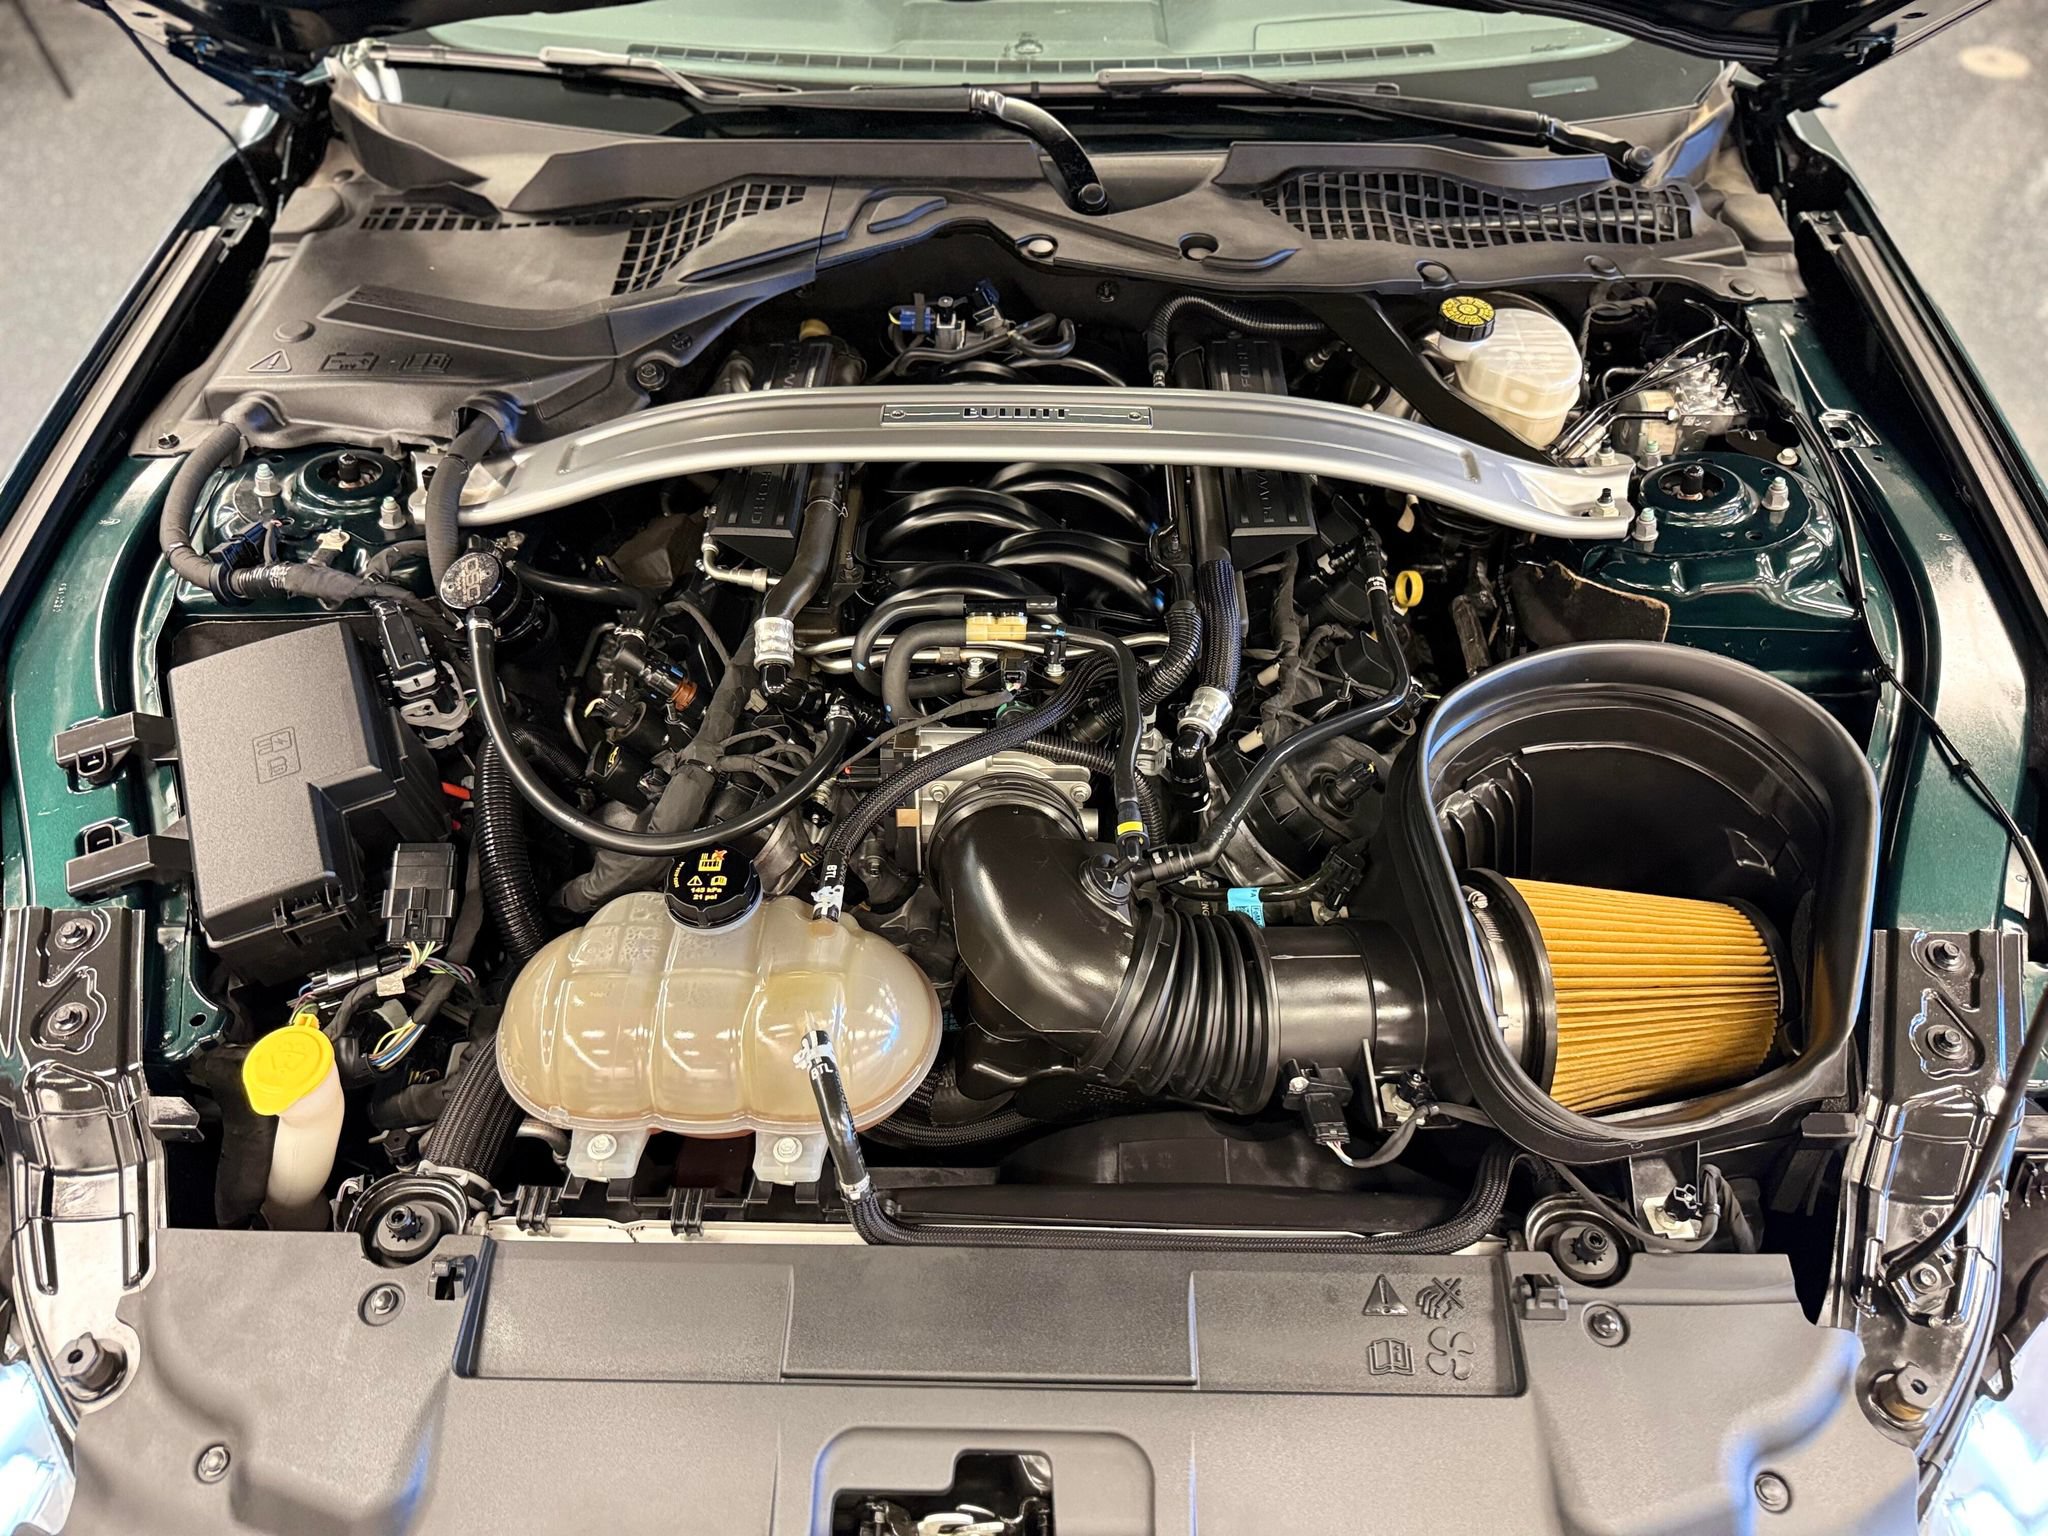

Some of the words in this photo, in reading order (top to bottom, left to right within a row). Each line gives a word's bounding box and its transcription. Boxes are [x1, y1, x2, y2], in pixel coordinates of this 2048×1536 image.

[962, 407, 1070, 419] BULLITT
[824, 864, 838, 881] BTL
[810, 1062, 834, 1081] BTL
